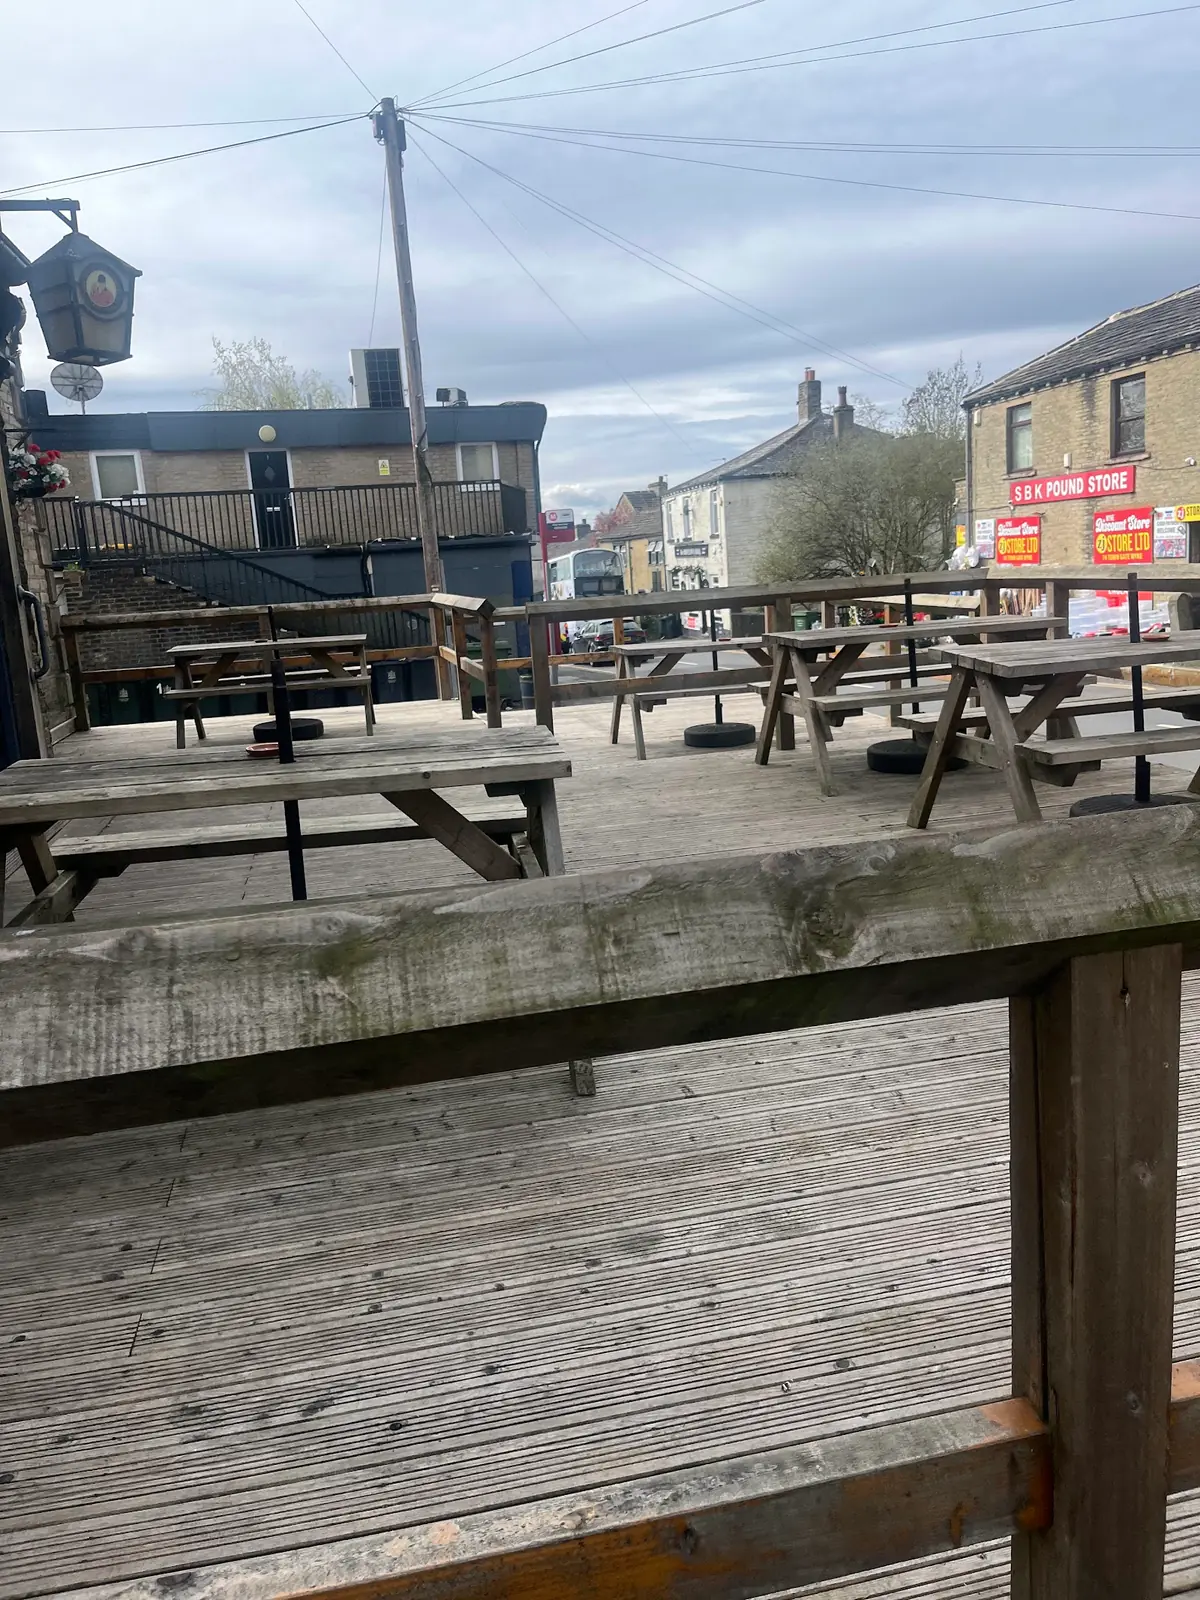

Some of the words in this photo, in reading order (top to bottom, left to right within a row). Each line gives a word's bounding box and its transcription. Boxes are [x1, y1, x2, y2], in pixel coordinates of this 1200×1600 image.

[1046, 477, 1084, 498] POUND
[1088, 471, 1128, 493] STORE
[1095, 517, 1127, 533] Discount
[1127, 514, 1151, 531] Store
[1006, 537, 1026, 554] STORE
[1026, 536, 1038, 553] LTD
[1107, 532, 1133, 552] STORE
[1134, 531, 1150, 551] LTD
